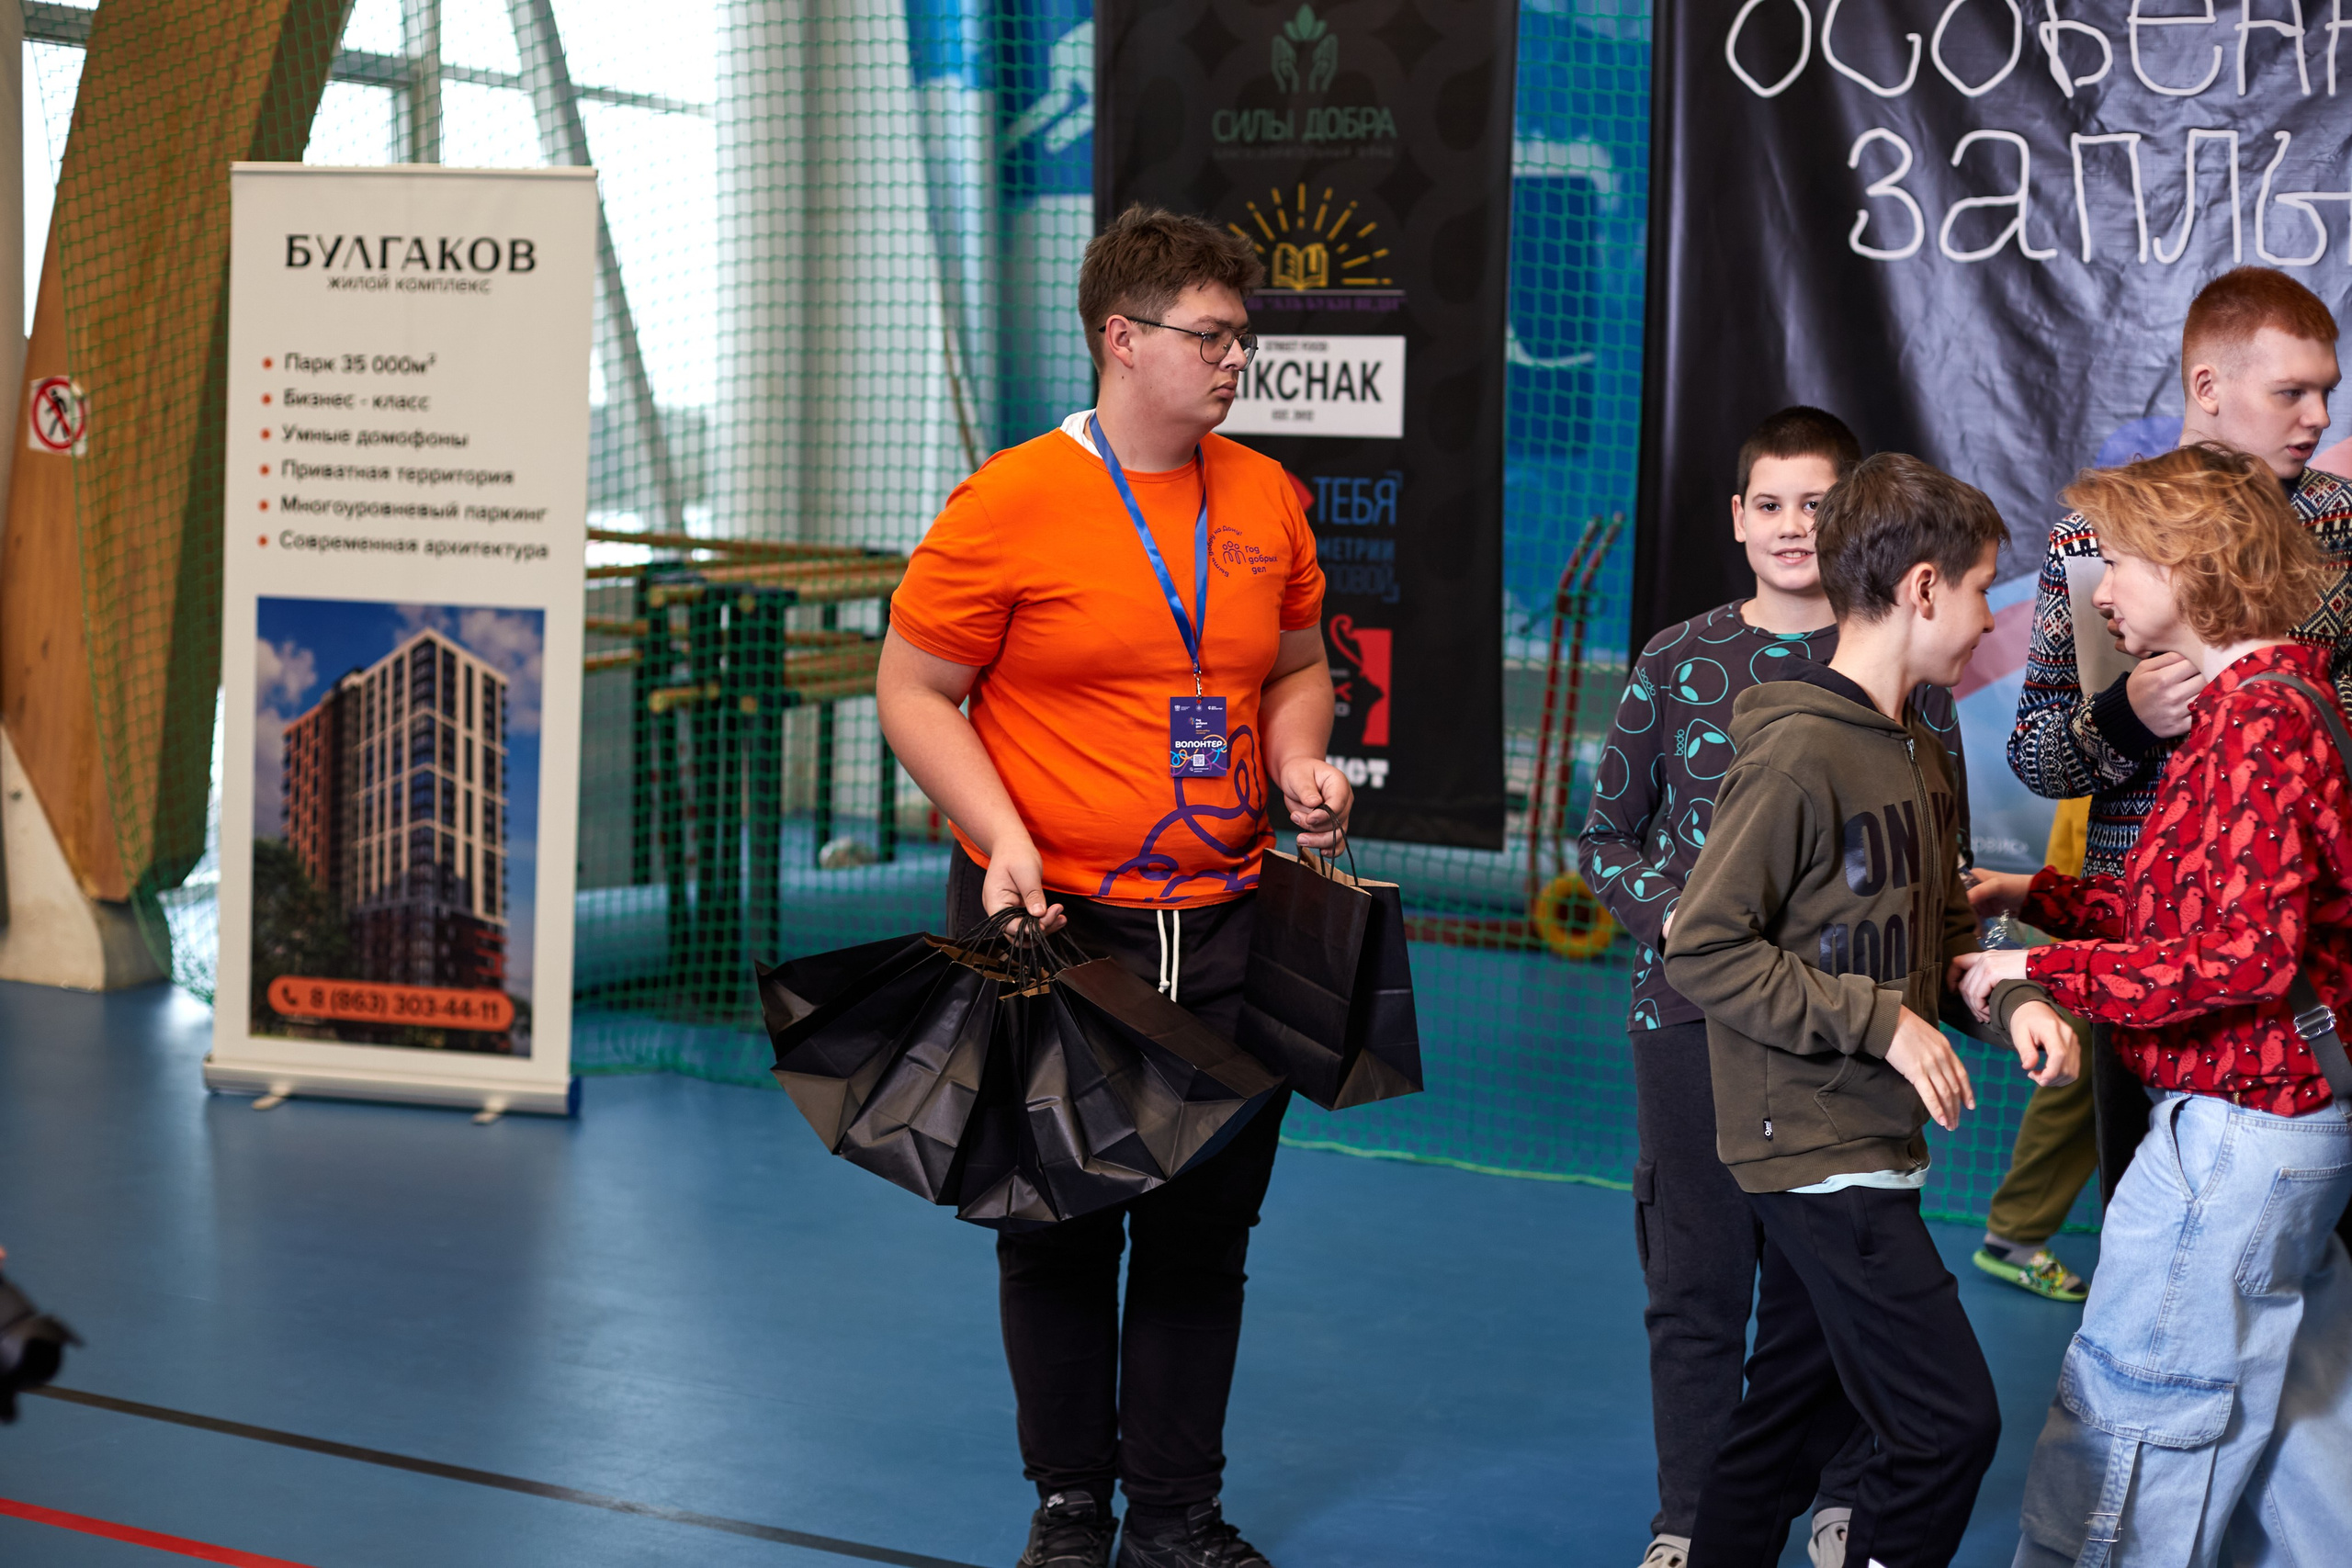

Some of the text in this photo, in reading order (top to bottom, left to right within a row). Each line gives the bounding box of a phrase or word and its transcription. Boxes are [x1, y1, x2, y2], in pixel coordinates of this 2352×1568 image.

[1212, 106, 1396, 142] СИЛЫ ДОБРА
[284, 234, 537, 274] БУЛГАКОВ
[327, 275, 492, 294] жилой комплекс
[284, 353, 334, 375] Парк
[341, 355, 366, 374] 35
[1235, 360, 1382, 402] IKCHAK
[284, 389, 353, 409] Бизнес
[372, 393, 430, 411] класс
[281, 424, 469, 449] Умные домофоны
[281, 460, 514, 487] Приватная территория
[280, 496, 547, 524] Многоуровневый паркинг
[279, 530, 548, 560] Современная архитектура
[1245, 546, 1260, 554] Год
[1317, 537, 1395, 561] МЕТРИИ
[1249, 555, 1277, 564] добрых
[1175, 740, 1223, 749] ВОЛОНТЕР
[310, 987, 499, 1021] 8 (863) 303-44-11
